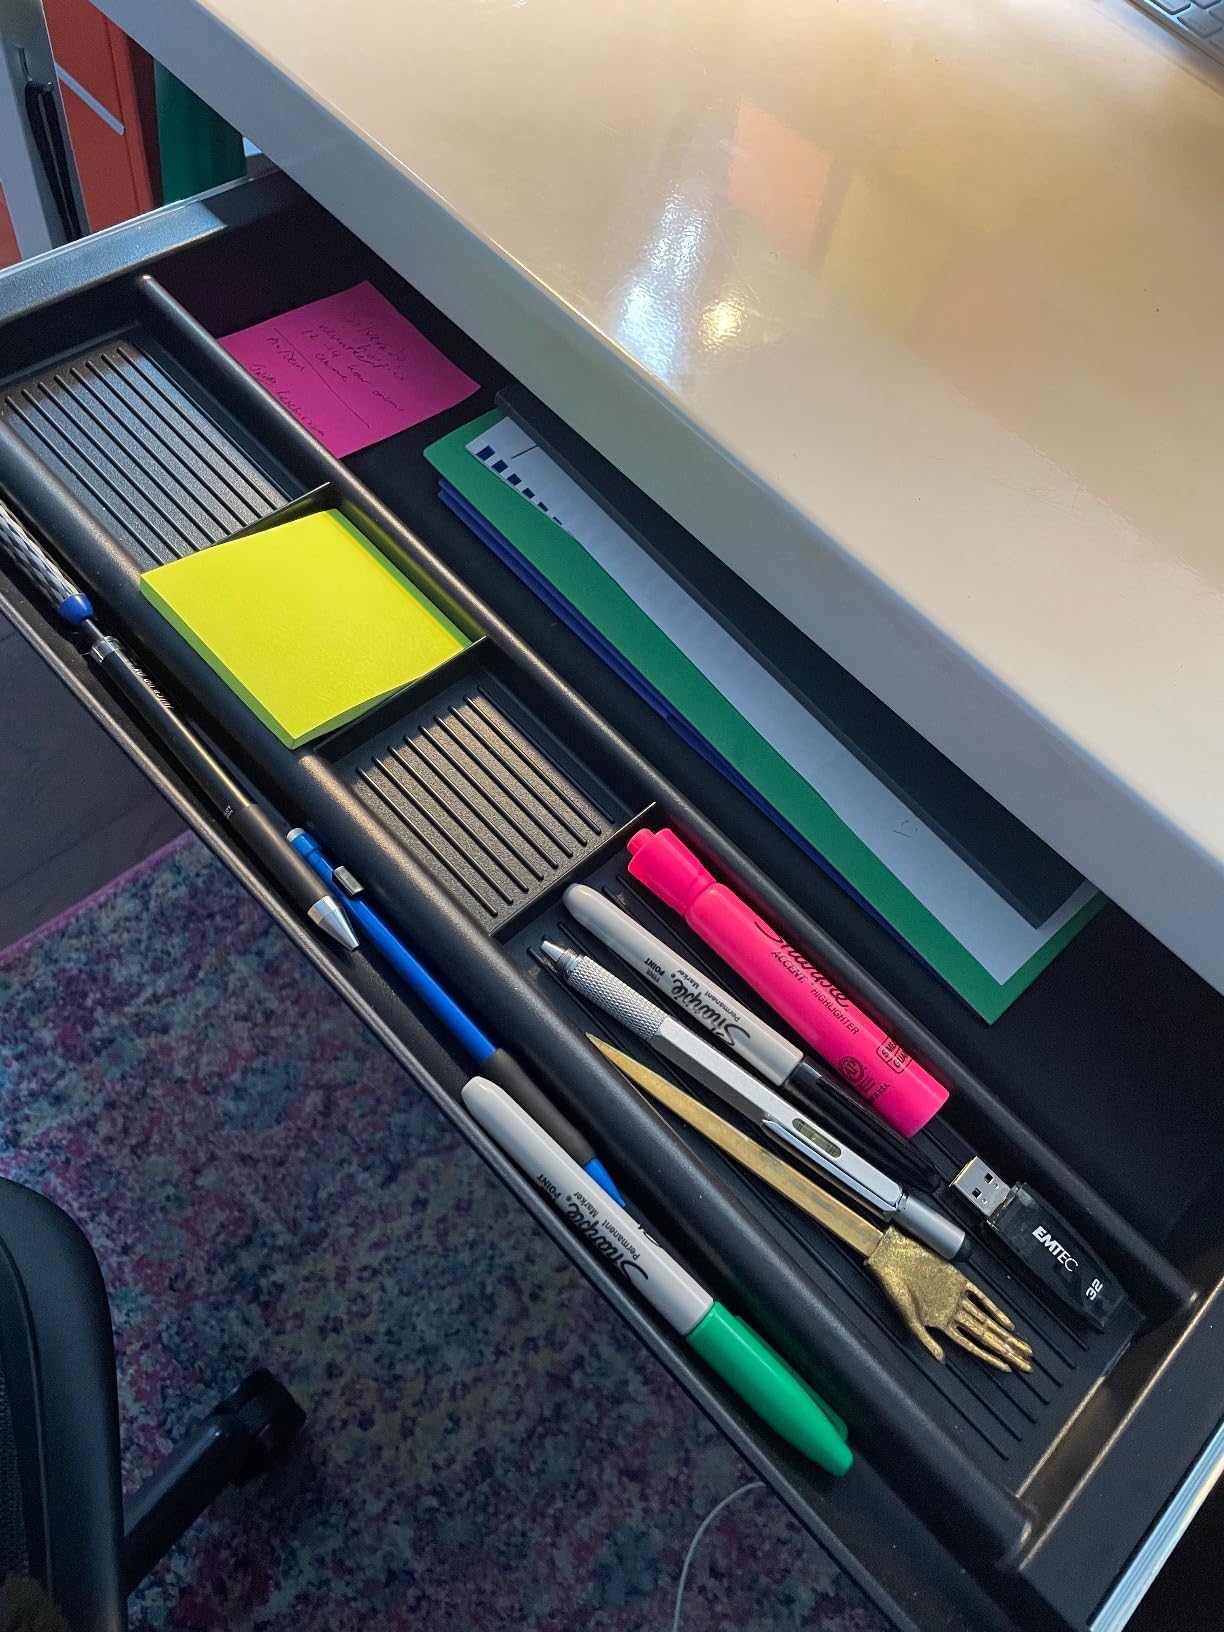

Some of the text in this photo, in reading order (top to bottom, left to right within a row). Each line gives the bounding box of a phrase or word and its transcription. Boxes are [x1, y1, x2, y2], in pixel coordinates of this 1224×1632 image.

[643, 956, 666, 978] POINT
[671, 978, 751, 1047] Sharpie
[676, 968, 741, 1022] Permanent Marker
[810, 987, 861, 1036] HIGHLIGHTER
[536, 1173, 562, 1200] POINT
[573, 1191, 641, 1261] Permanent Marker
[1031, 1225, 1079, 1273] EMTEC
[1085, 1278, 1104, 1301] 32
